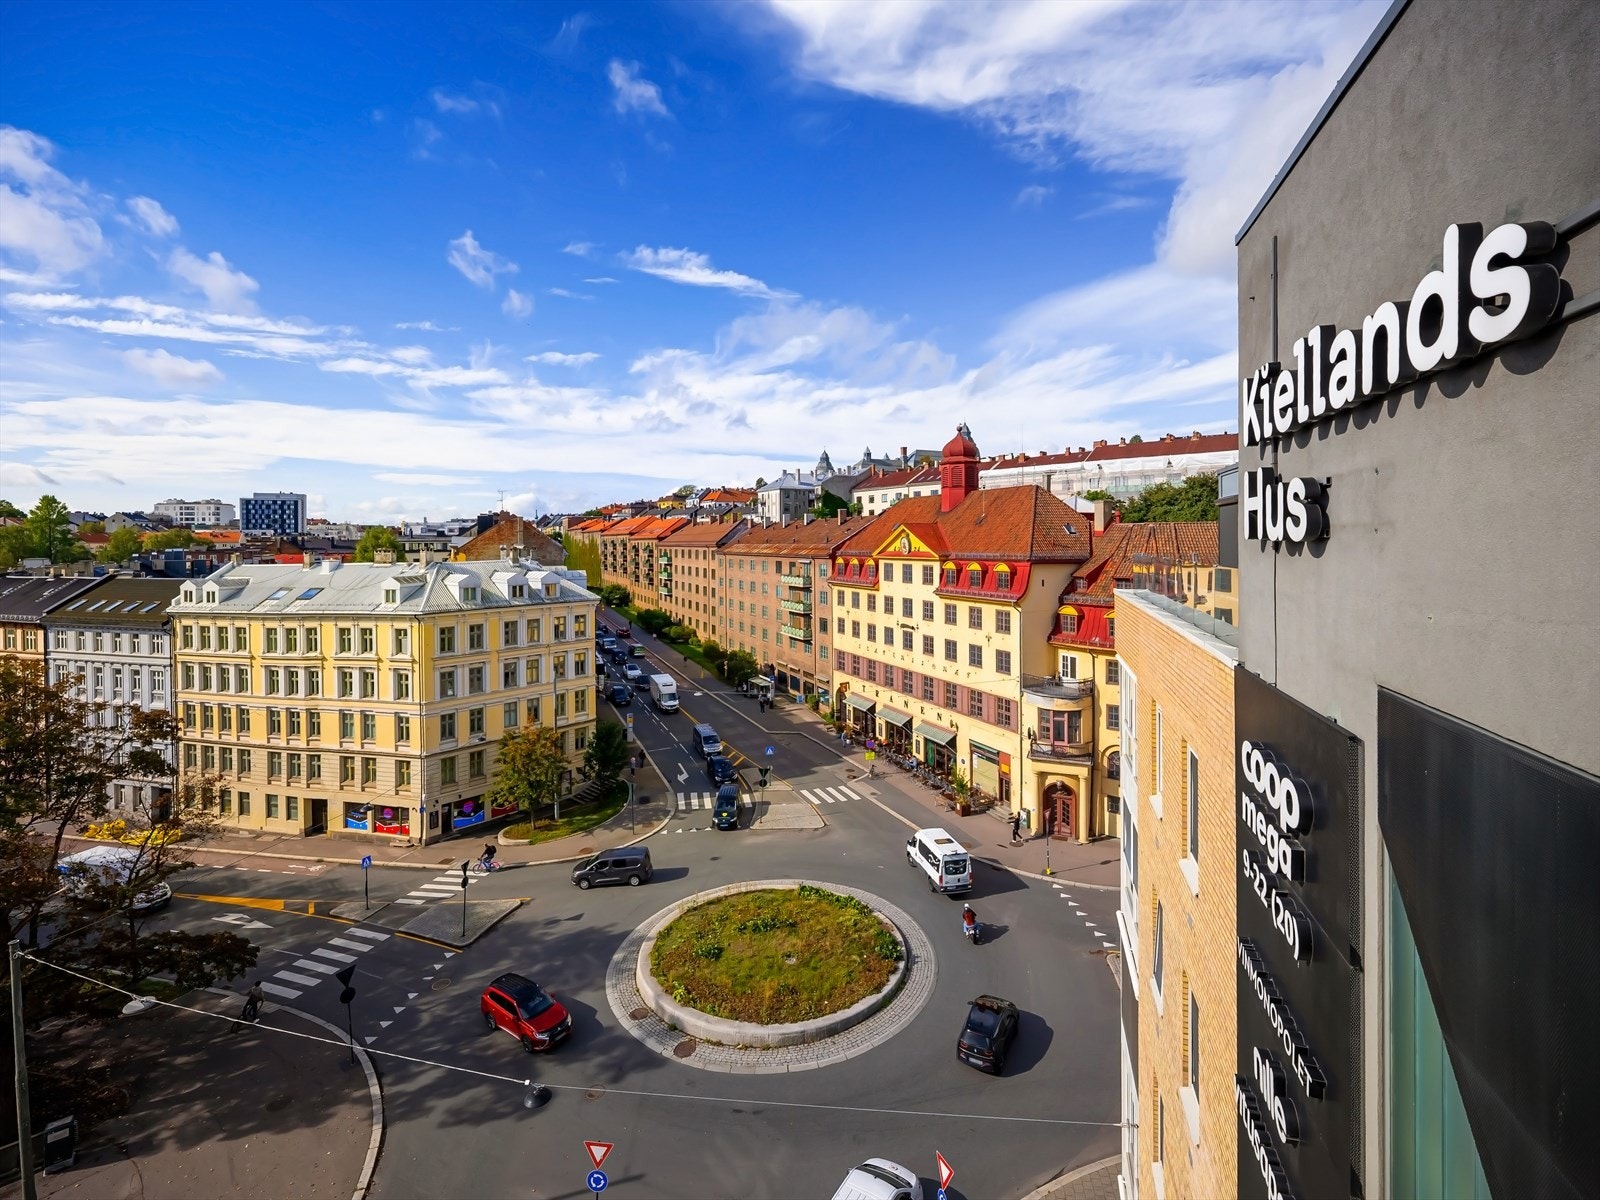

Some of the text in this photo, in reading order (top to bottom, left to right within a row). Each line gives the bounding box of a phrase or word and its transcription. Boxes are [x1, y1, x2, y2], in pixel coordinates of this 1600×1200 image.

[1243, 223, 1531, 447] Kiellands
[1243, 467, 1307, 542] Hus
[862, 684, 943, 722] TRANEN
[1241, 740, 1299, 833] coop
[1241, 792, 1292, 882] mega
[1243, 849, 1299, 961] 9-22 (20)
[1234, 1074, 1284, 1200] vitusap
[1253, 1046, 1287, 1144] nille
